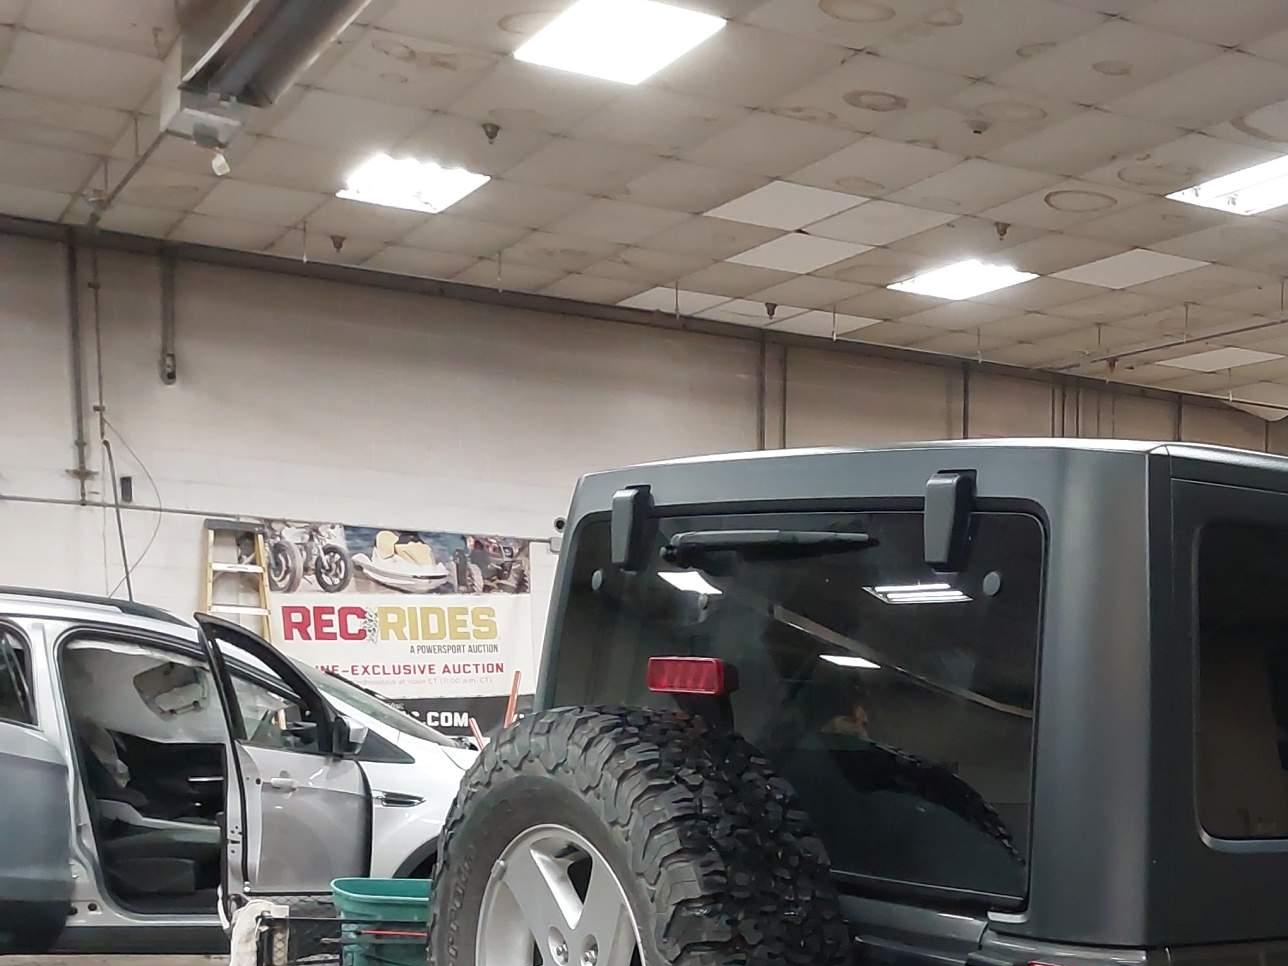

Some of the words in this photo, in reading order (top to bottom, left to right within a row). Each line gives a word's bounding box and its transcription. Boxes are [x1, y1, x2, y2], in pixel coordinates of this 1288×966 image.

[281, 606, 369, 641] REC
[377, 606, 498, 641] RIDES
[410, 645, 415, 655] A
[417, 644, 465, 655] POWERSPORT
[468, 644, 499, 653] AUCTION
[315, 664, 436, 676] NE-EXCLUSIVE
[442, 663, 504, 675] AUCTION
